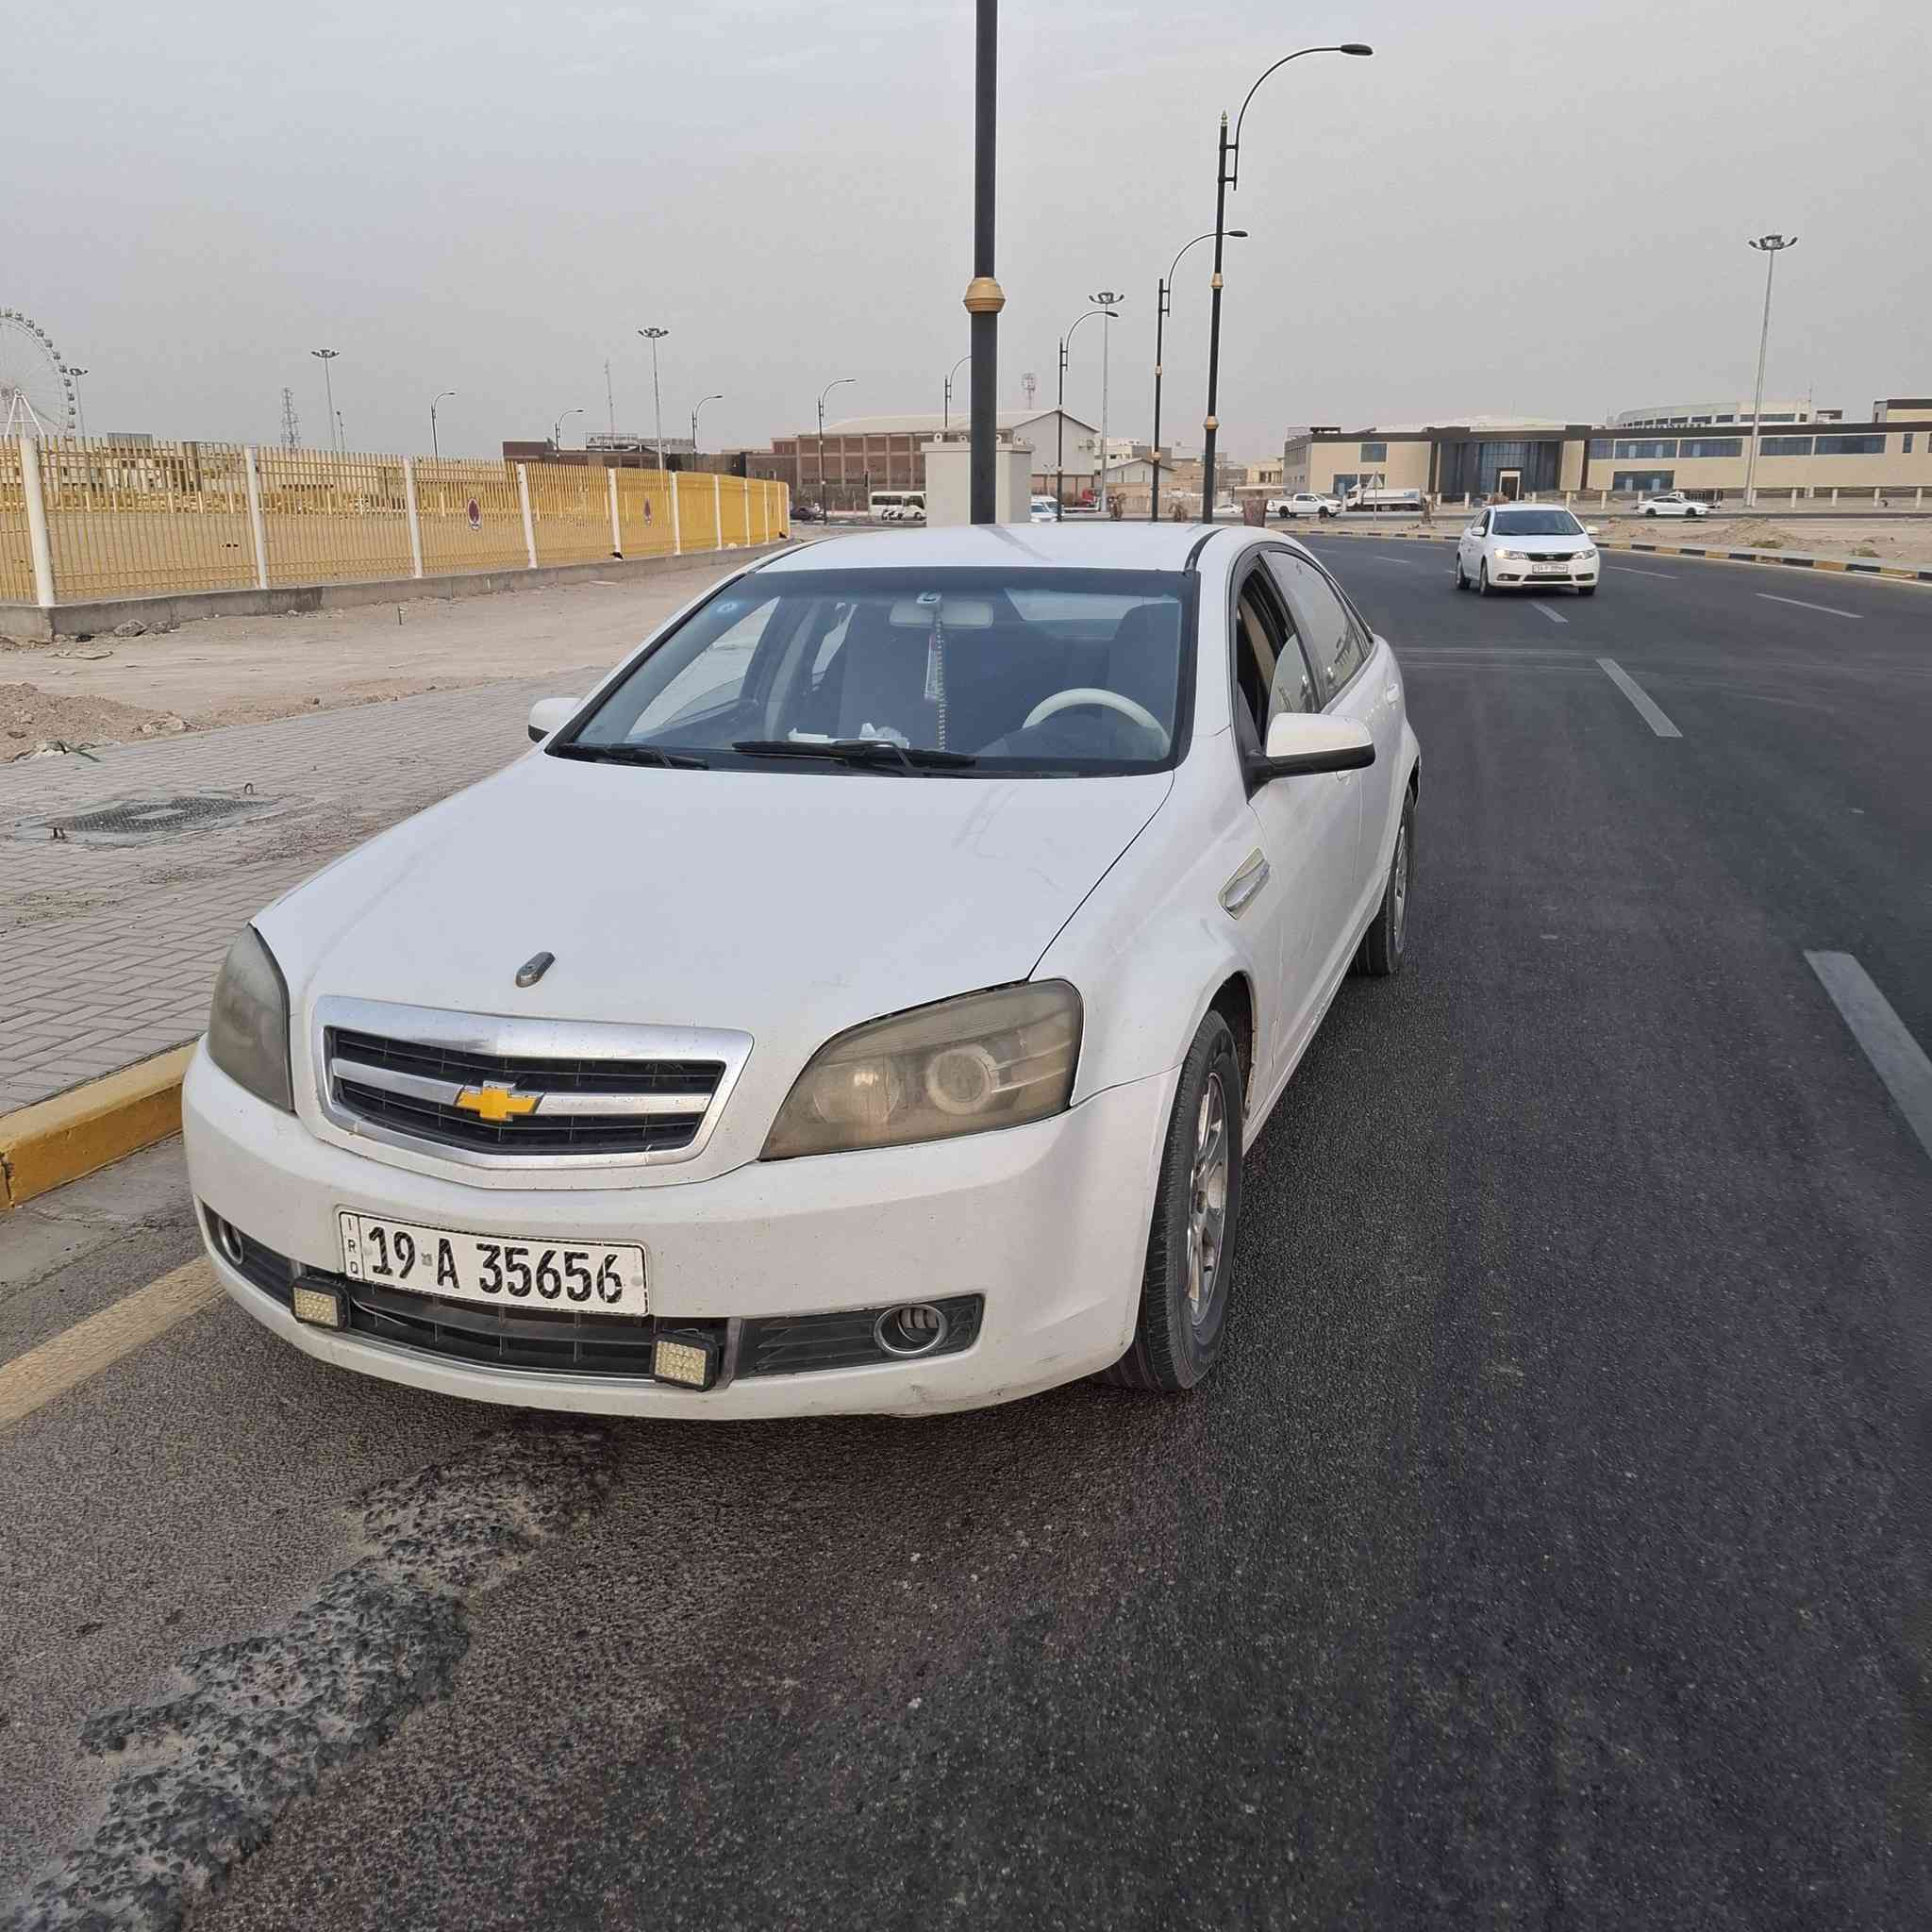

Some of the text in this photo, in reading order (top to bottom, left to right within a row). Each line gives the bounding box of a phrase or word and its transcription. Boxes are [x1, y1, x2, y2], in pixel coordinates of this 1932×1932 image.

[369, 1226, 623, 1304] 19 A 35656
